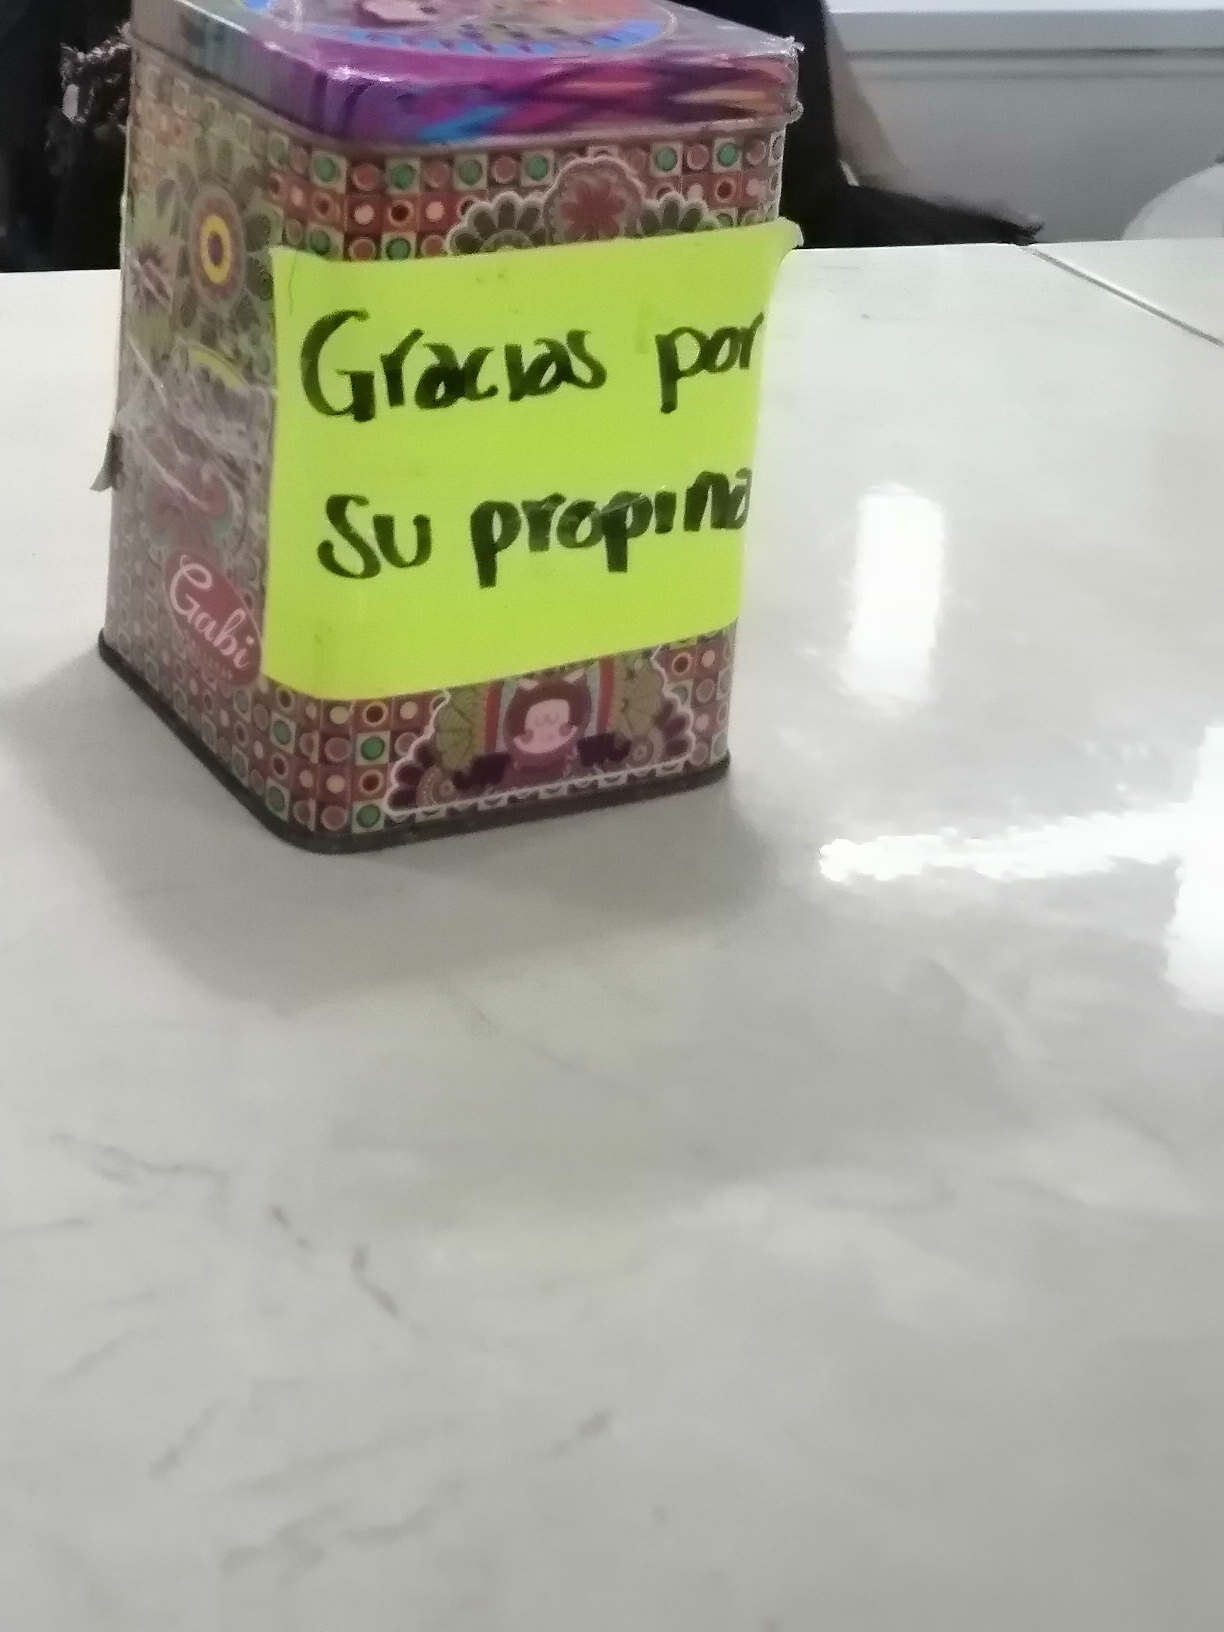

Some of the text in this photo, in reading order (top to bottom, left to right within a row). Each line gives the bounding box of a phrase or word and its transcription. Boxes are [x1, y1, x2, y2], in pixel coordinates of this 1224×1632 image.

[300, 309, 764, 423] Gracias por
[470, 468, 753, 589] propina
[169, 554, 251, 669] Gabi
